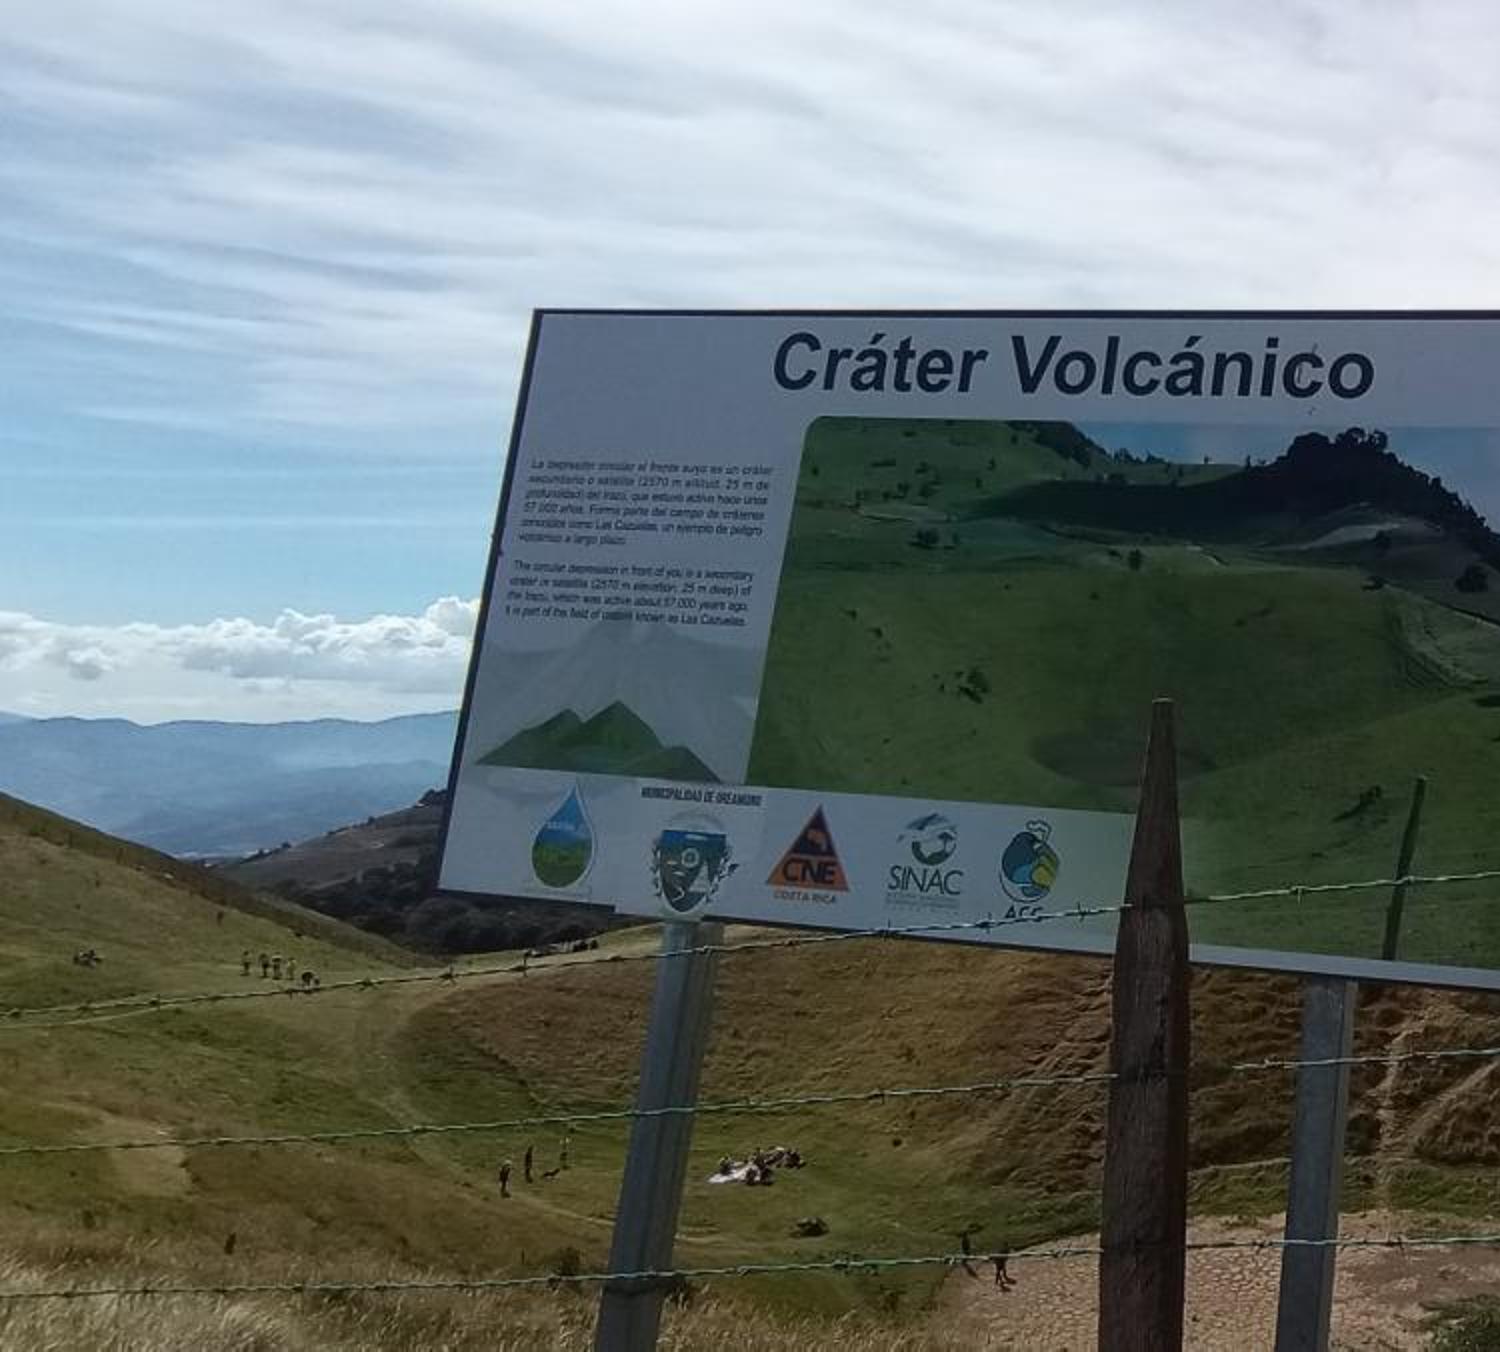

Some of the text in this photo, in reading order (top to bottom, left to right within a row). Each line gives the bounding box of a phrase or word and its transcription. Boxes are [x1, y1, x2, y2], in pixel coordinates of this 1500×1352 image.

[774, 332, 1376, 399] Cráter Volcánico
[782, 857, 837, 885] CNE
[887, 864, 965, 896] SINAC
[774, 889, 810, 902] COSTA
